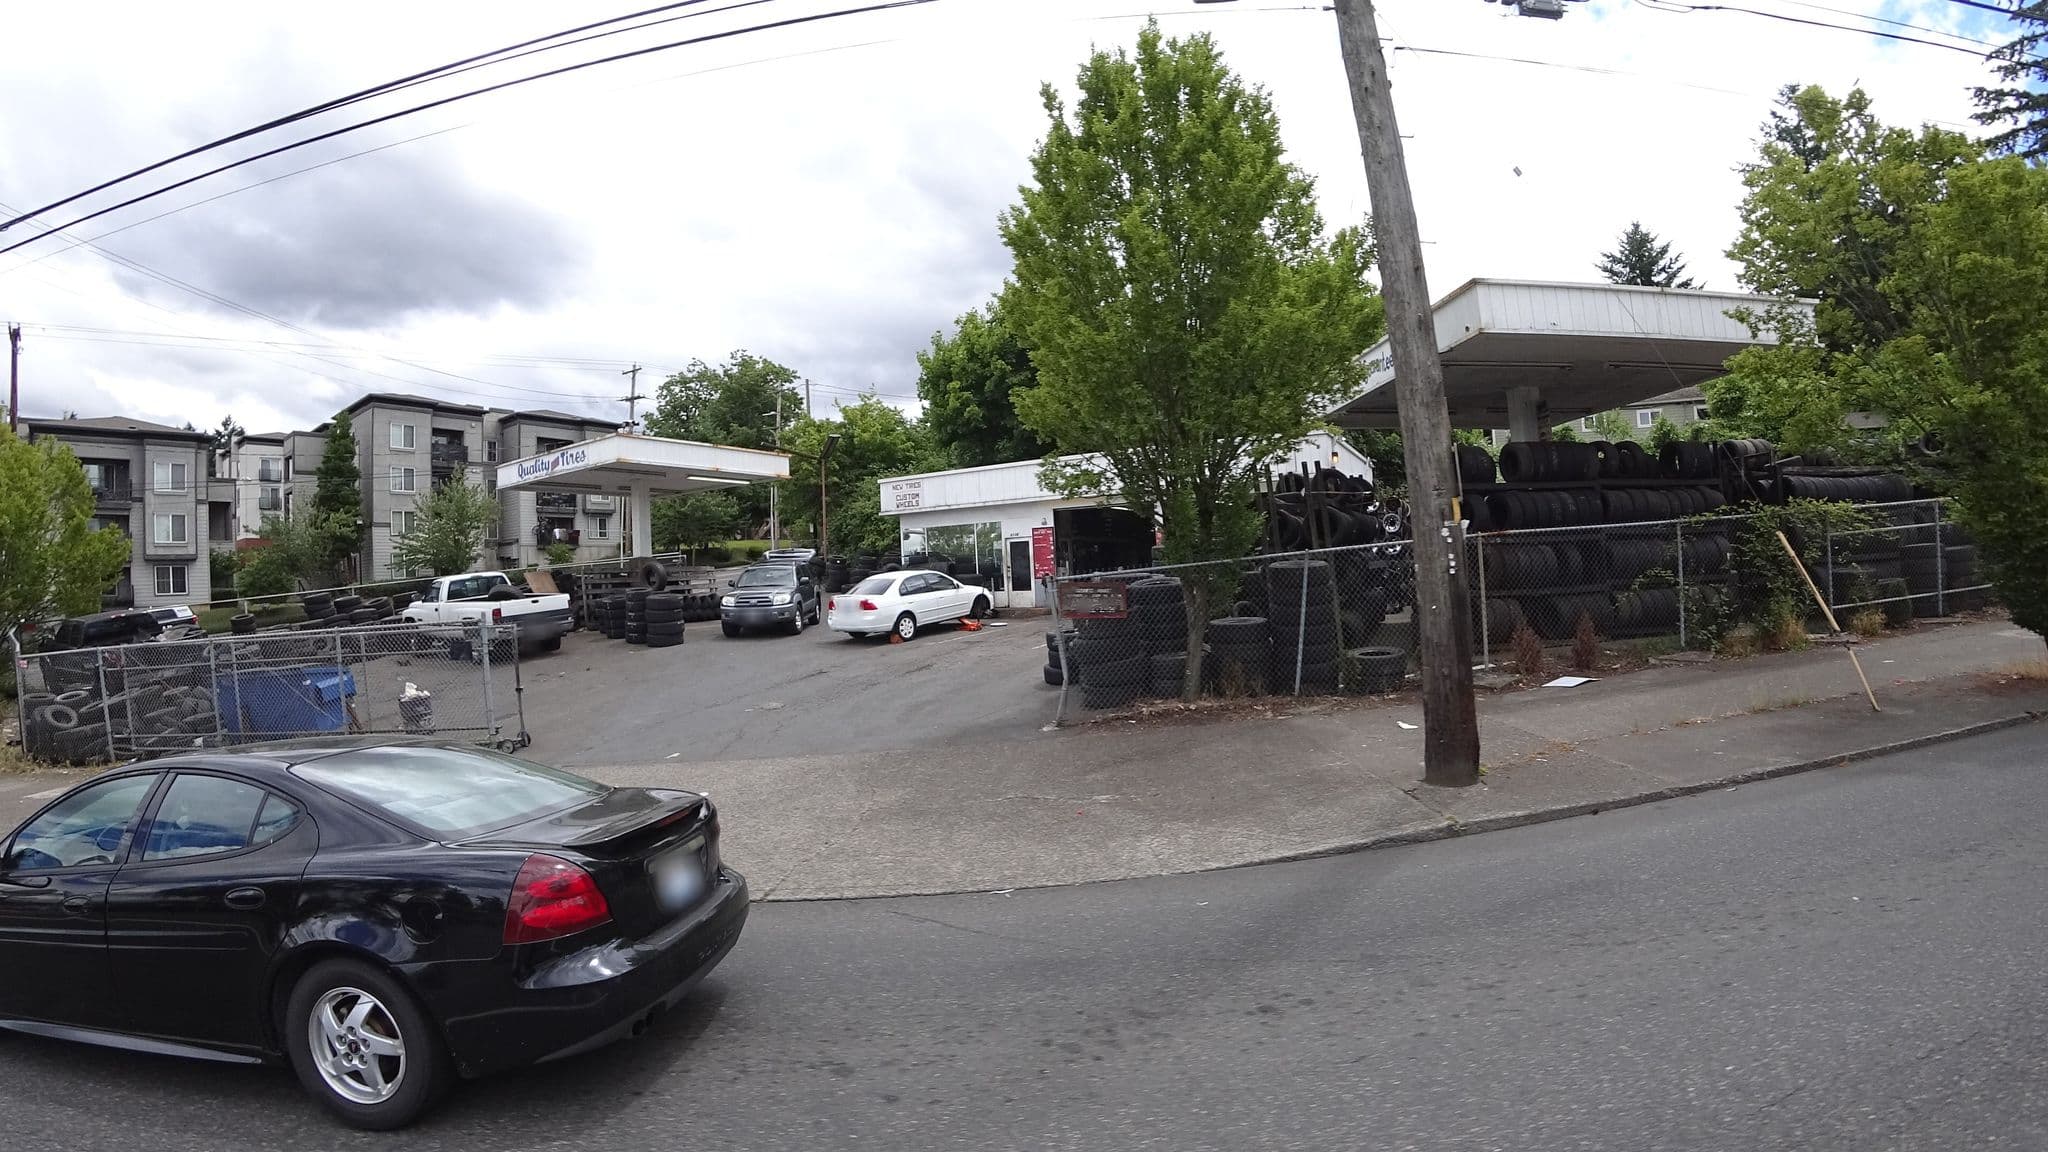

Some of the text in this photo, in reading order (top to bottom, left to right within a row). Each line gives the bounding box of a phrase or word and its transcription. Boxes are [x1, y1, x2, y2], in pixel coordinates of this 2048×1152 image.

[518, 450, 586, 480] Quality Tires
[905, 481, 921, 489] TIRES
[896, 492, 919, 501] CUSTOM
[896, 499, 919, 508] WHEELS
